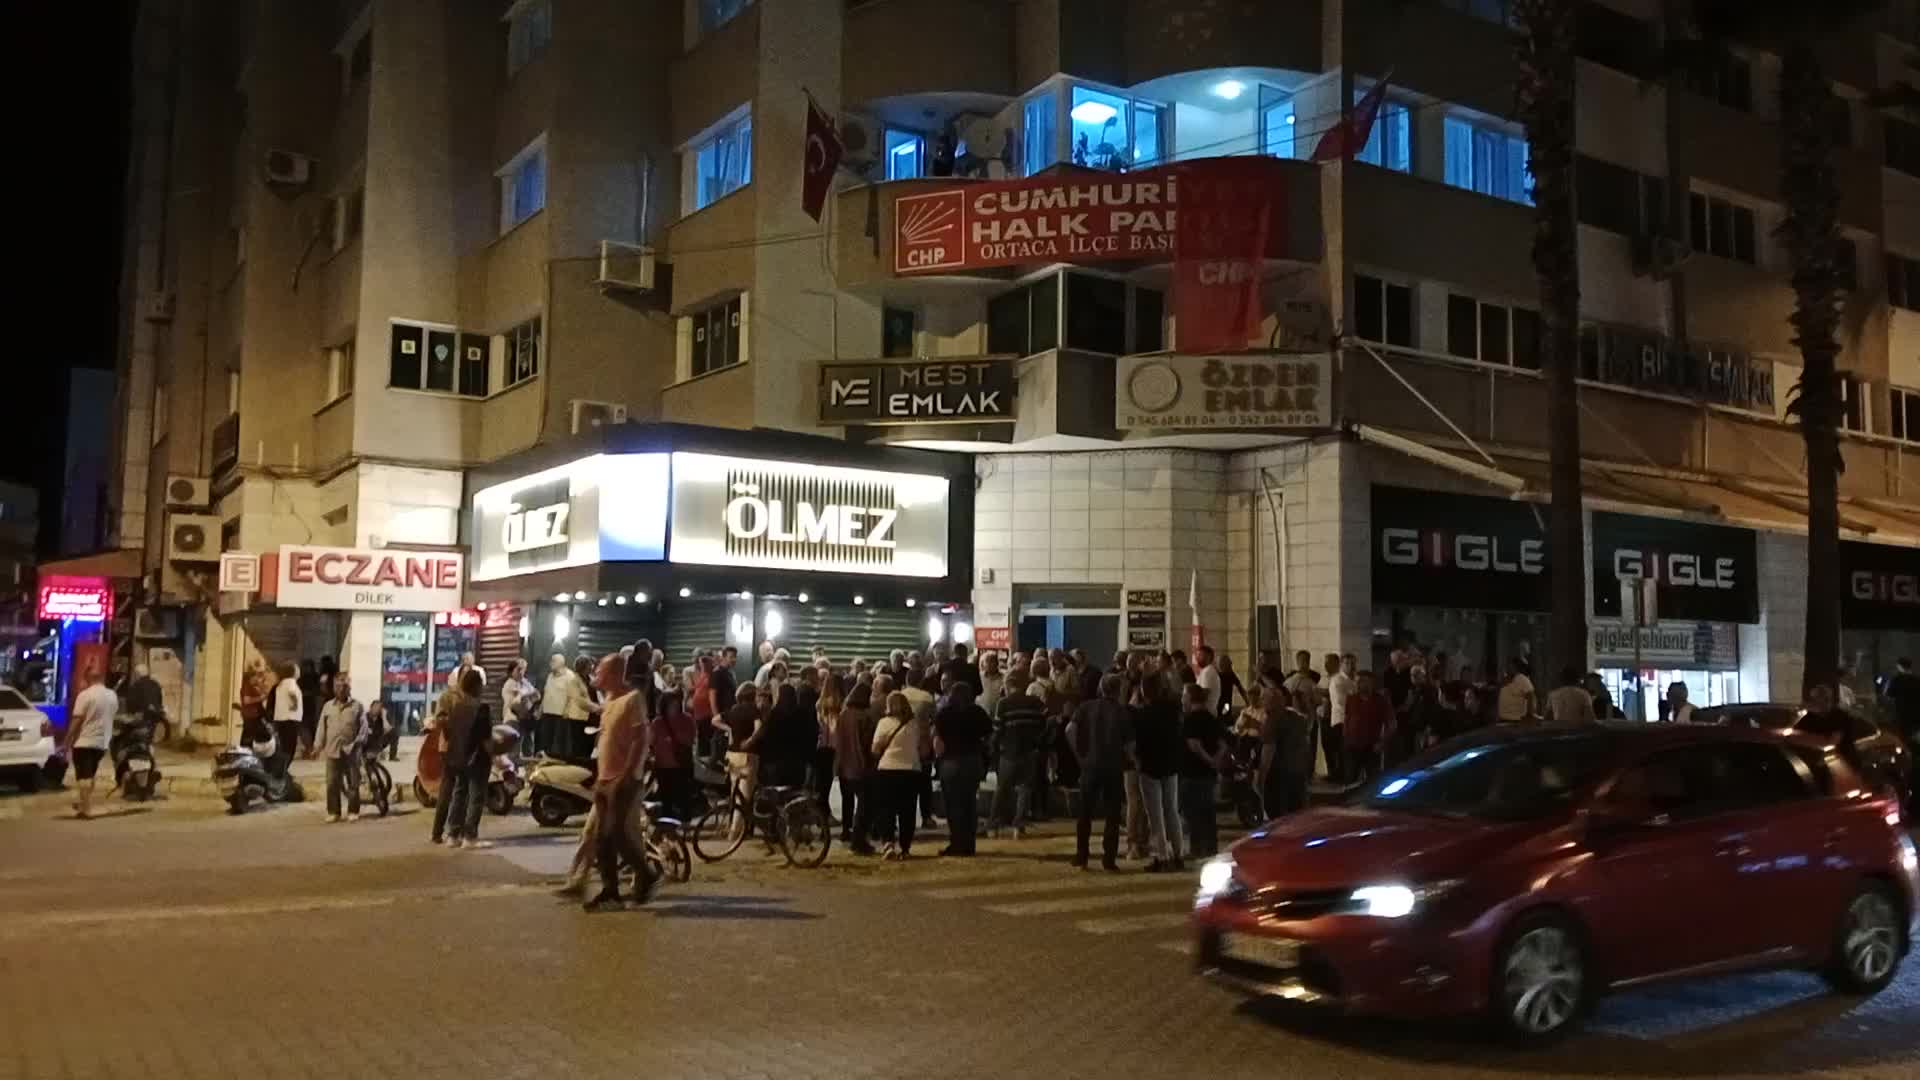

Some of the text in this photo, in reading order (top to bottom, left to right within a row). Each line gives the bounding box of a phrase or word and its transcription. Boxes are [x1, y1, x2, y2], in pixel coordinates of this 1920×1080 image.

[974, 176, 1177, 215] CUMHURİ
[972, 213, 1090, 243] HALK
[907, 248, 945, 266] CHP
[981, 239, 1058, 259] ORTACA
[1070, 233, 1119, 255] İLÇE
[900, 363, 991, 387] MEST
[889, 391, 1000, 415] EMLAK
[1204, 388, 1318, 412] EMLAK
[727, 482, 897, 549] ÖLMEZ
[289, 552, 458, 589] ECZANE
[1614, 549, 1735, 589] GIGLE
[355, 591, 393, 604] DİLEK
